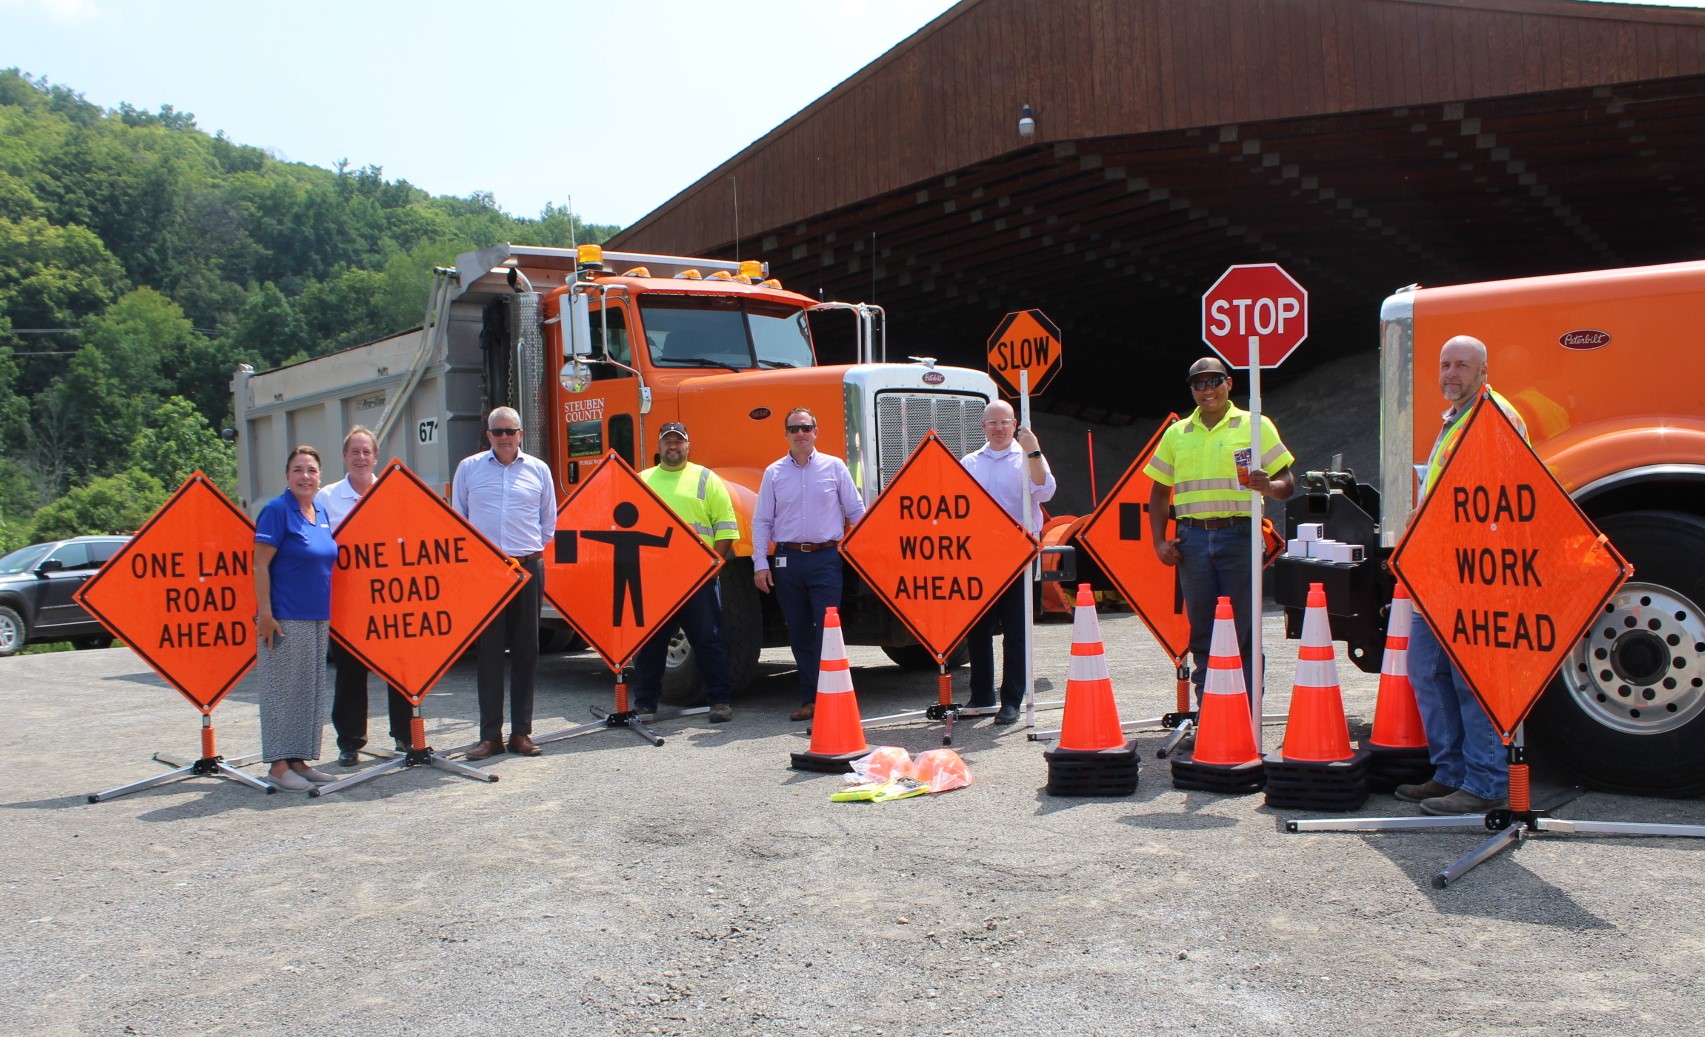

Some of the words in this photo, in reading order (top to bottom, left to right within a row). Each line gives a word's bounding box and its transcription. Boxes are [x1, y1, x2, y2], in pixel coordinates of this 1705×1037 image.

[1209, 297, 1300, 336] STOP
[997, 335, 1050, 372] SLOW
[1564, 333, 1606, 345] Peterbilt
[564, 398, 605, 413] STEUBEN
[565, 409, 604, 422] COUNTY
[899, 494, 971, 520] ROAD
[1453, 484, 1536, 523] ROAD
[337, 542, 389, 571] ONE
[401, 537, 468, 567] LANE
[899, 535, 972, 560] WORK
[131, 552, 185, 579] ONE
[199, 550, 254, 576] LAN
[1455, 547, 1542, 587] WORK
[166, 586, 236, 613] ROAD
[370, 575, 440, 604] ROAD
[894, 575, 984, 601] AHEAD
[158, 621, 247, 649] AHEAD
[365, 610, 452, 641] AHEAD
[1452, 608, 1556, 652] AHEAD
